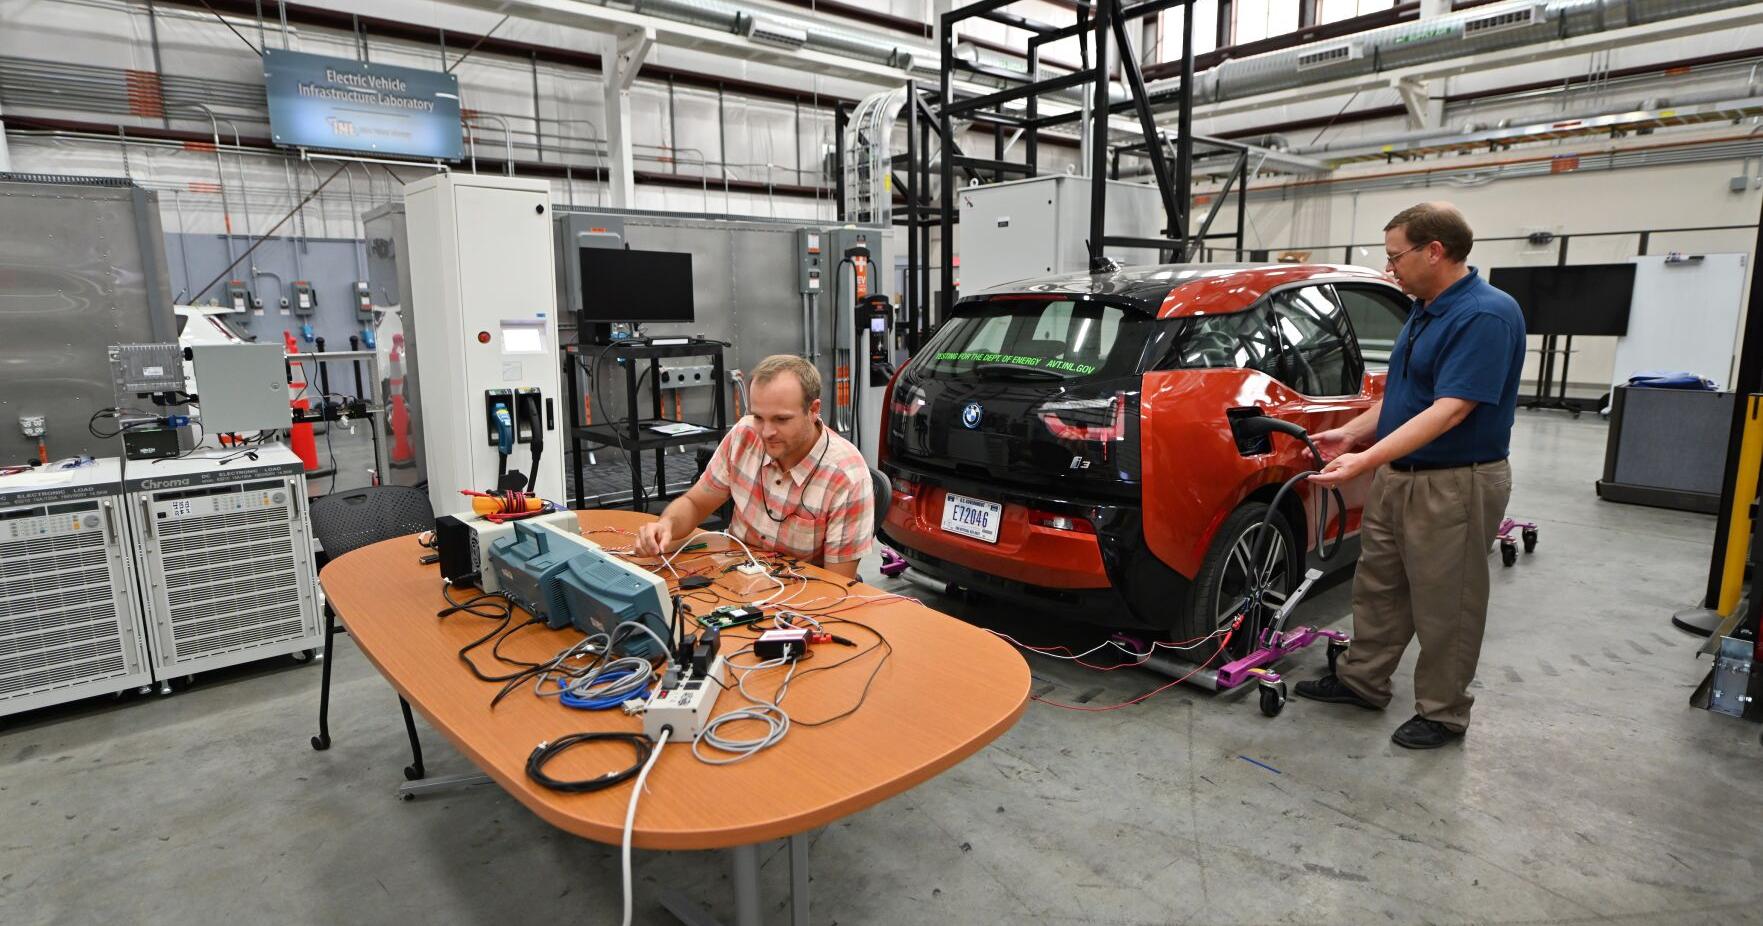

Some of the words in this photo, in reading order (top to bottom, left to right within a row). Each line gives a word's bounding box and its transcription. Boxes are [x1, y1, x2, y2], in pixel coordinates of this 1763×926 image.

[326, 69, 367, 87] Electric
[368, 75, 406, 92] Vehicle
[298, 83, 376, 104] Infrastructure
[378, 93, 434, 113] Laboratory
[936, 352, 958, 360] TESTING
[970, 353, 984, 361] THE
[983, 354, 1000, 362] DEPT.
[1002, 355, 1012, 363] OF
[1012, 356, 1041, 366] ENERGY
[1046, 359, 1096, 375] AVT.INL.GOV
[16, 489, 66, 499] ELECTRONIC
[140, 478, 190, 490] Chroma
[952, 504, 989, 528] E72046
